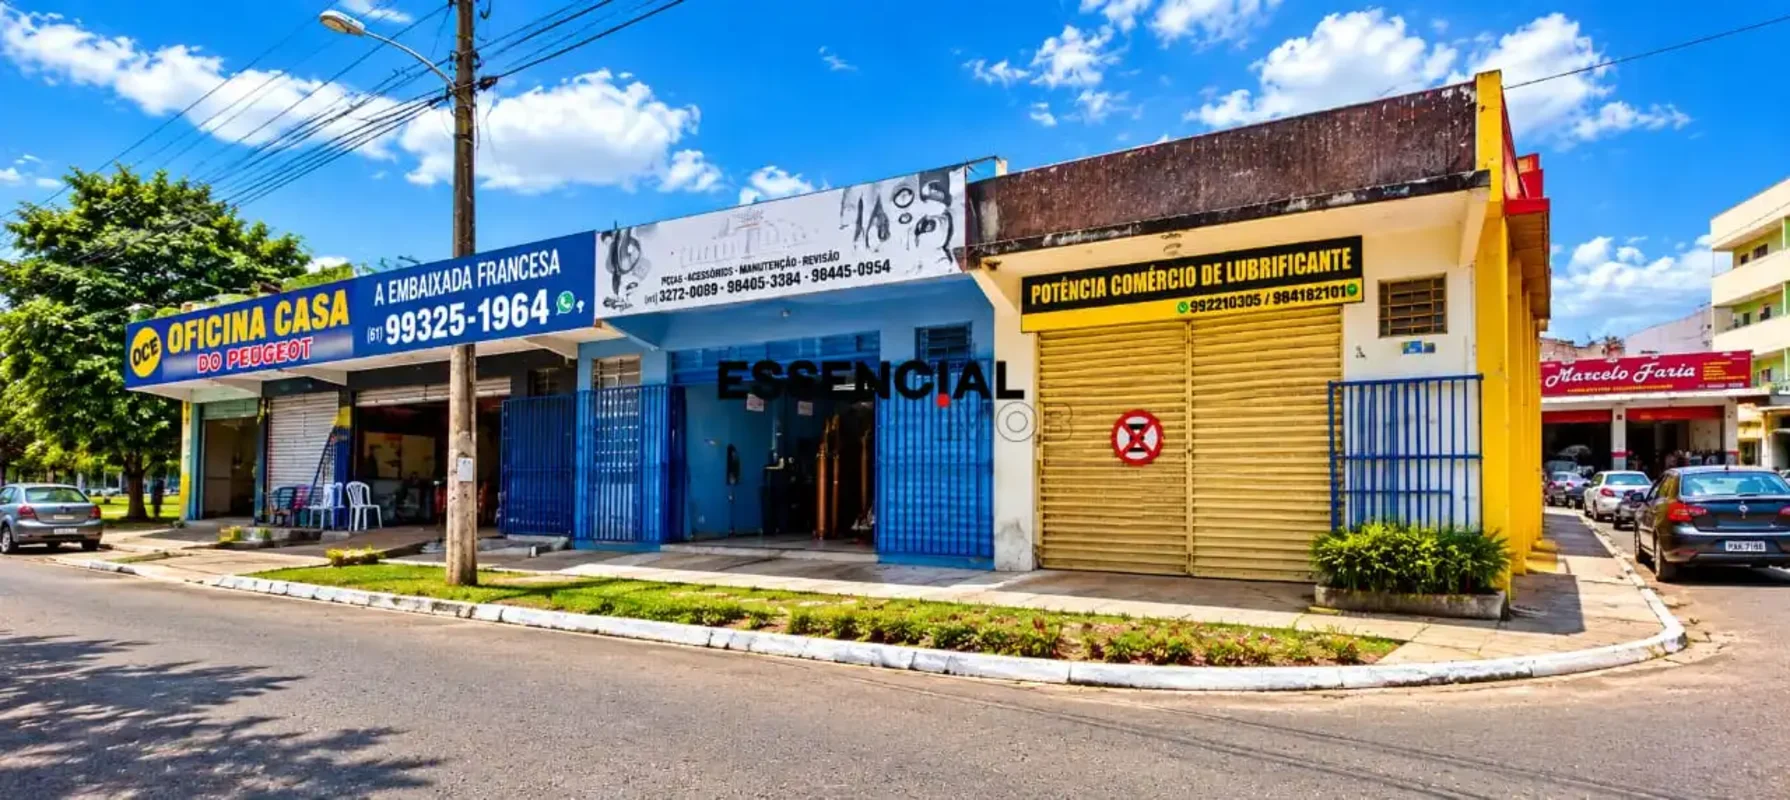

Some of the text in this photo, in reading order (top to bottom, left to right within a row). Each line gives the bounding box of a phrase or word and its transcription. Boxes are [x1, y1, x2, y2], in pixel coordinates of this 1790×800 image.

[374, 248, 561, 307] A EMBAIXADA FRANCESA
[727, 271, 801, 294] 98405-3384
[811, 259, 891, 283] 98445-0954
[739, 255, 797, 274] MANUTENÇÃO
[802, 249, 840, 266] REVISÃO
[1031, 247, 1352, 305] POTÊNCIA COMÉRCIO DE LUBRIFICANTE
[367, 288, 549, 346] (61) 99325-1964
[1190, 291, 1262, 314] 992210305
[1272, 285, 1346, 304] 984182101
[167, 289, 350, 354] OFICINA CASA
[132, 336, 159, 366] OCE
[197, 337, 313, 373] DO PEUGEOT
[1545, 364, 1628, 388] Marcelo
[1633, 361, 1696, 383] Faria
